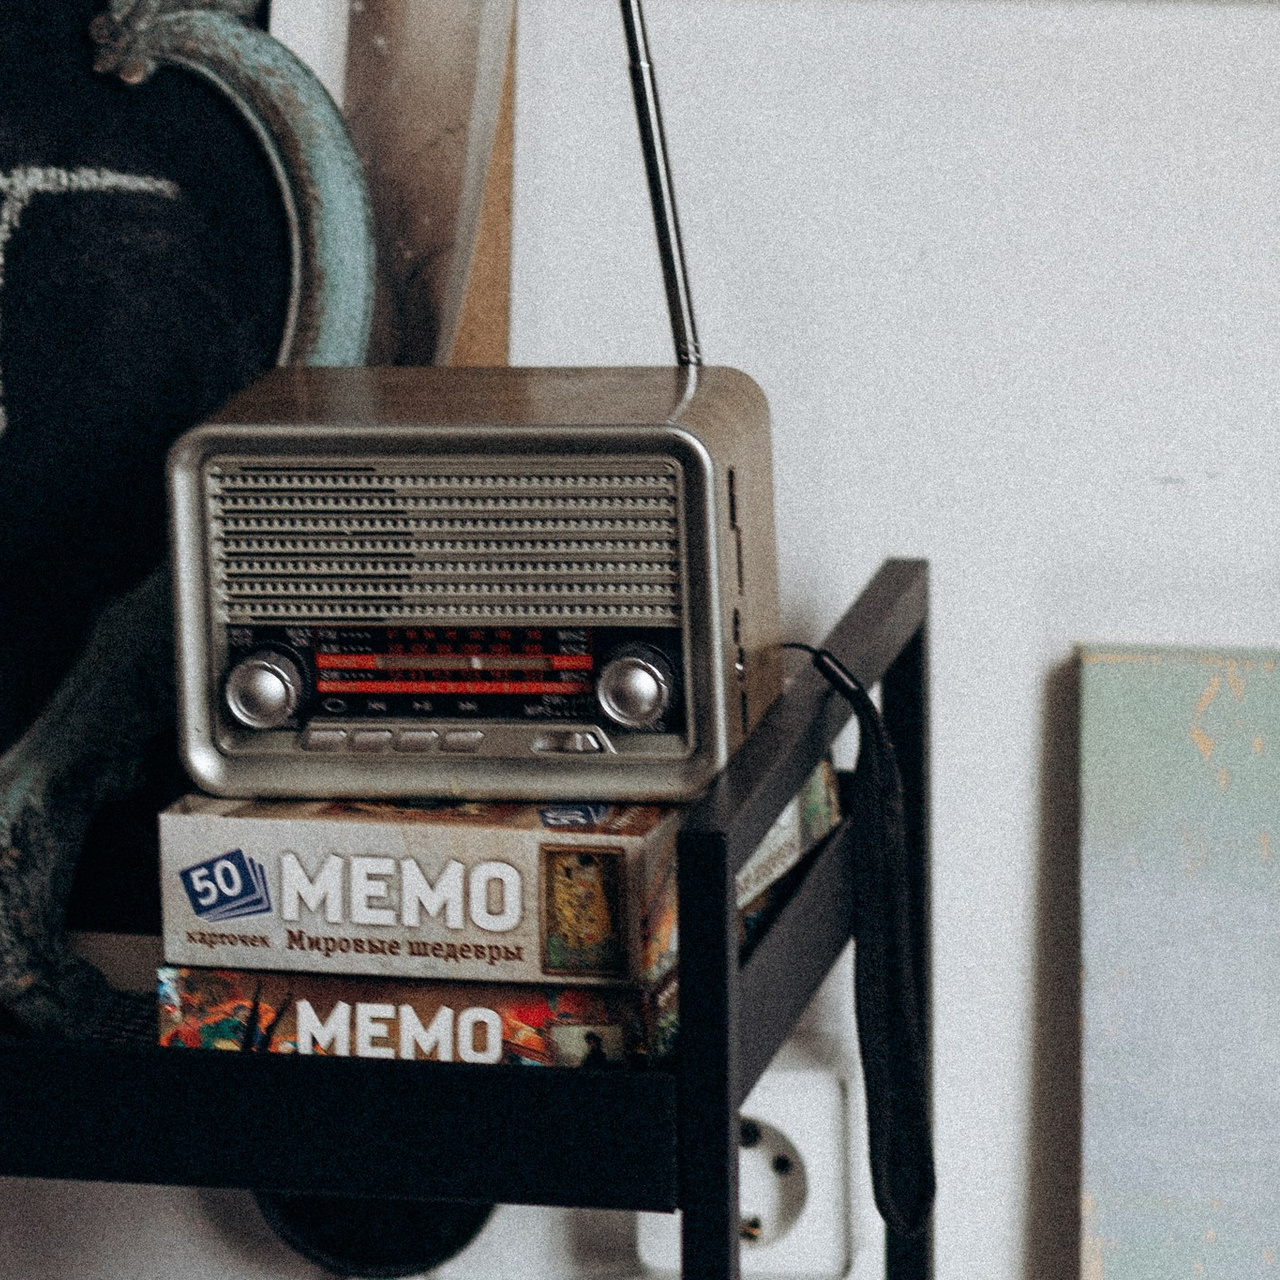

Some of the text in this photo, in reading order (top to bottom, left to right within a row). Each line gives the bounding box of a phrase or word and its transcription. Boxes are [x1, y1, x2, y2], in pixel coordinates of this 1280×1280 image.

[191, 849, 524, 933] 50 MEMO
[185, 928, 526, 965] карточек Мировые шедевры
[295, 997, 504, 1066] MEMO
